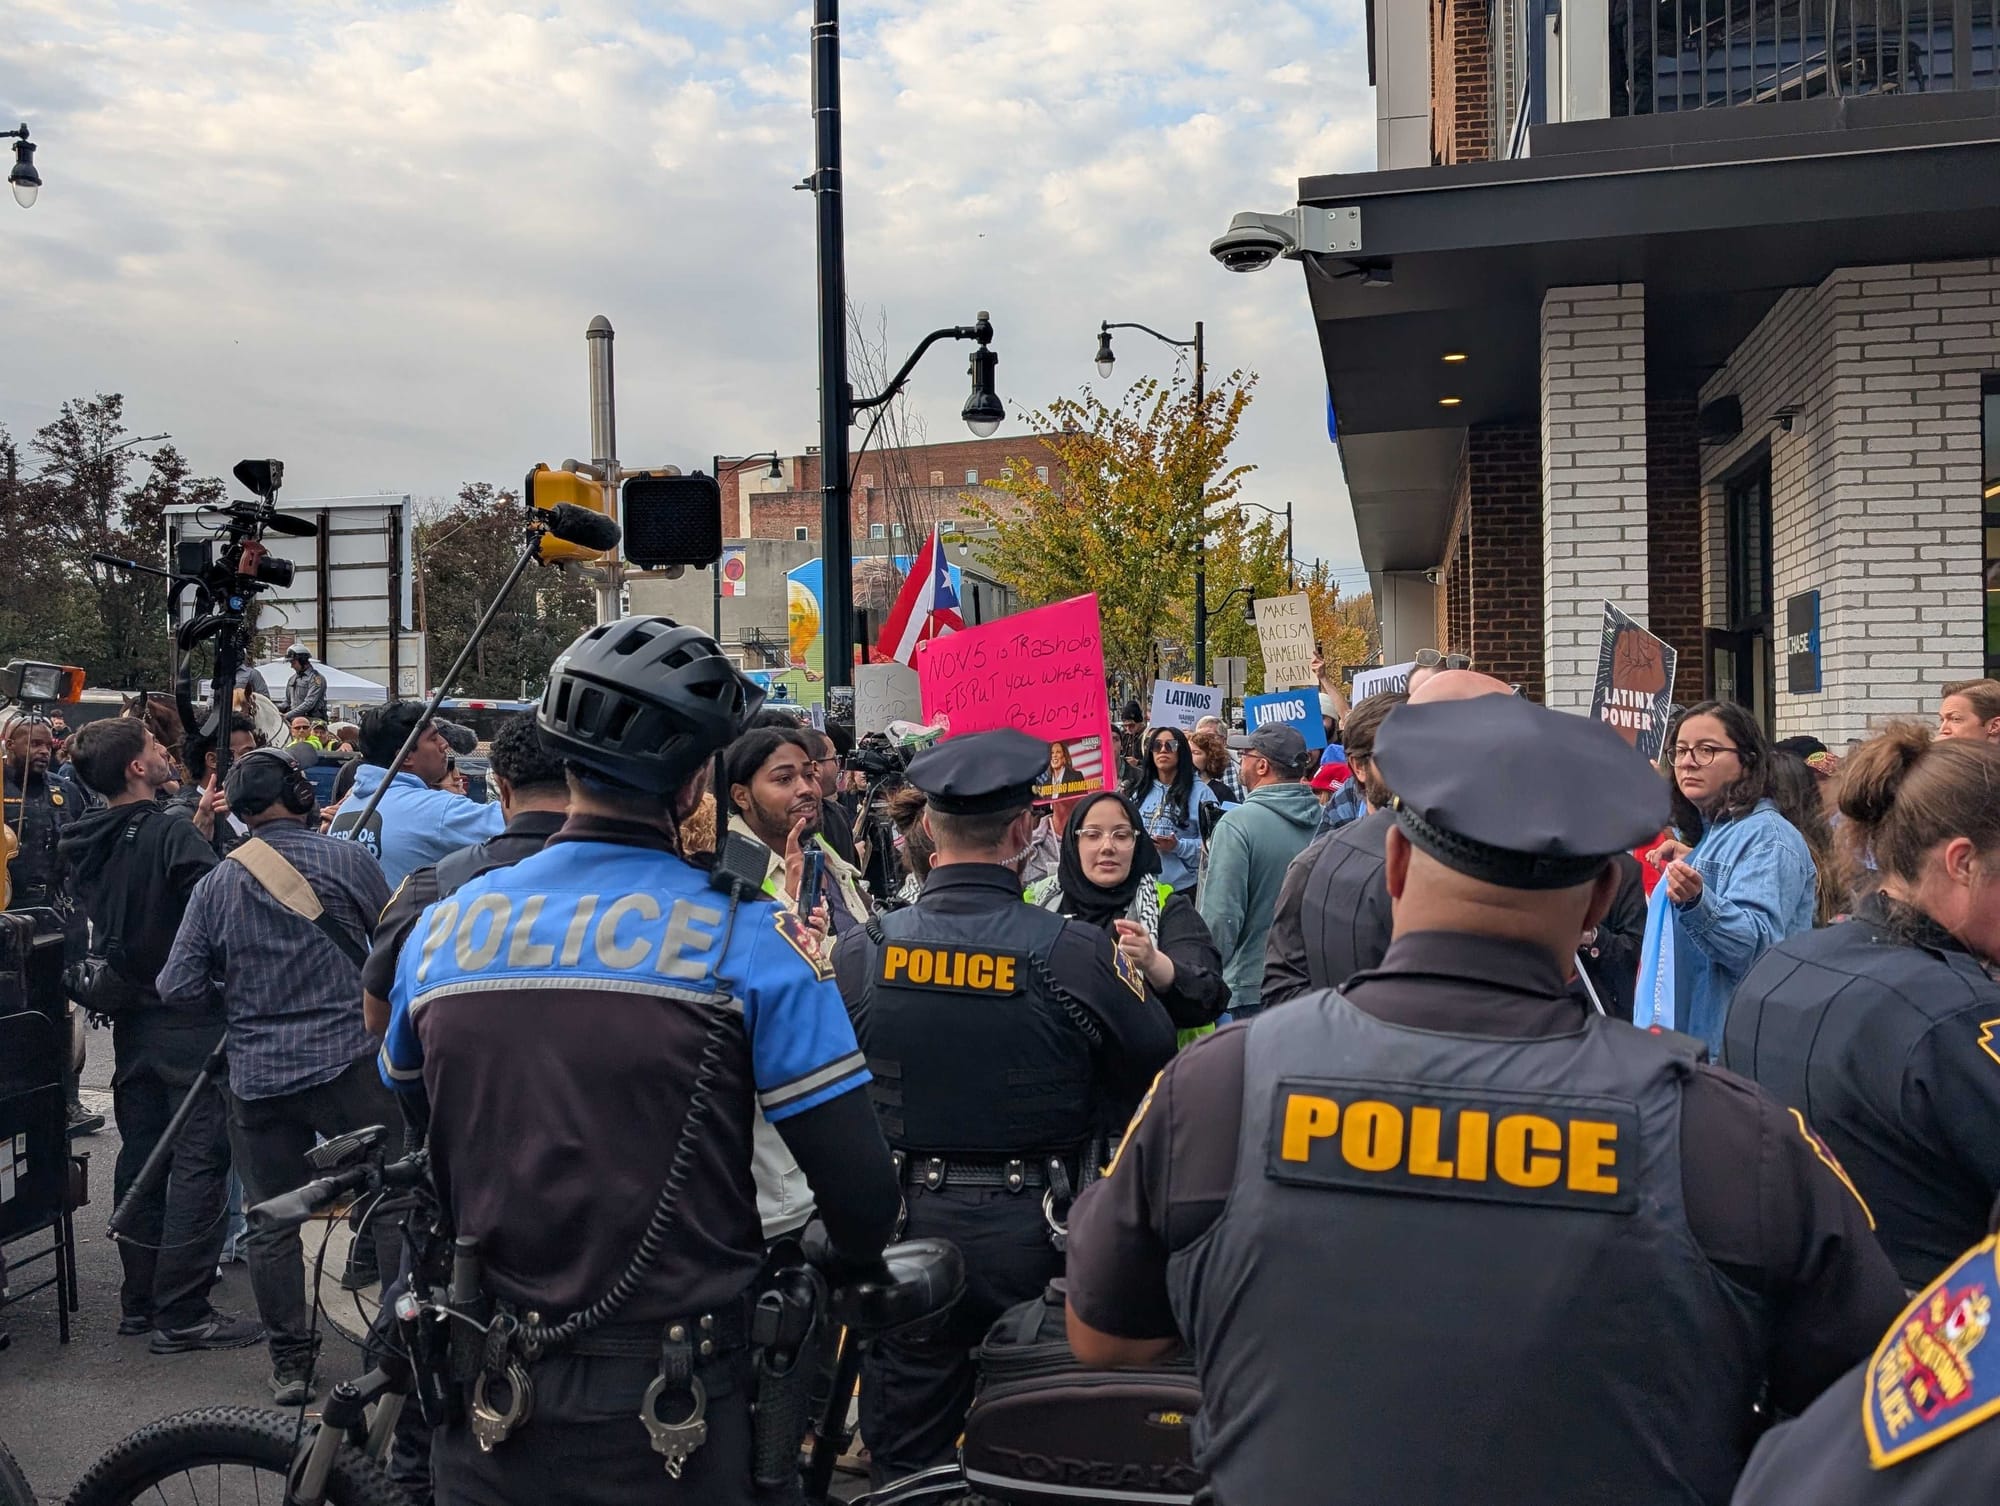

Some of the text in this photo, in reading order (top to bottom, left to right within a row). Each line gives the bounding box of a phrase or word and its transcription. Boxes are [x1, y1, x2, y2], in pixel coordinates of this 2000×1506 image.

[1263, 602, 1299, 619] MAKE
[1260, 622, 1310, 641] RACISM
[1263, 643, 1312, 664] SHAMEFUL
[1788, 632, 1809, 655] CHASE
[1275, 665, 1311, 683] AGAIN
[1362, 674, 1407, 699] LATINOS
[1165, 688, 1211, 709] LATINOS
[1604, 687, 1655, 710] LATINX
[1254, 699, 1307, 726] LATINOS
[1601, 707, 1651, 731] POWER
[416, 892, 722, 984] POLICE
[884, 945, 1016, 991] POLICE
[1281, 1094, 1618, 1194] POLICE
[1160, 1411, 1184, 1425] MTX
